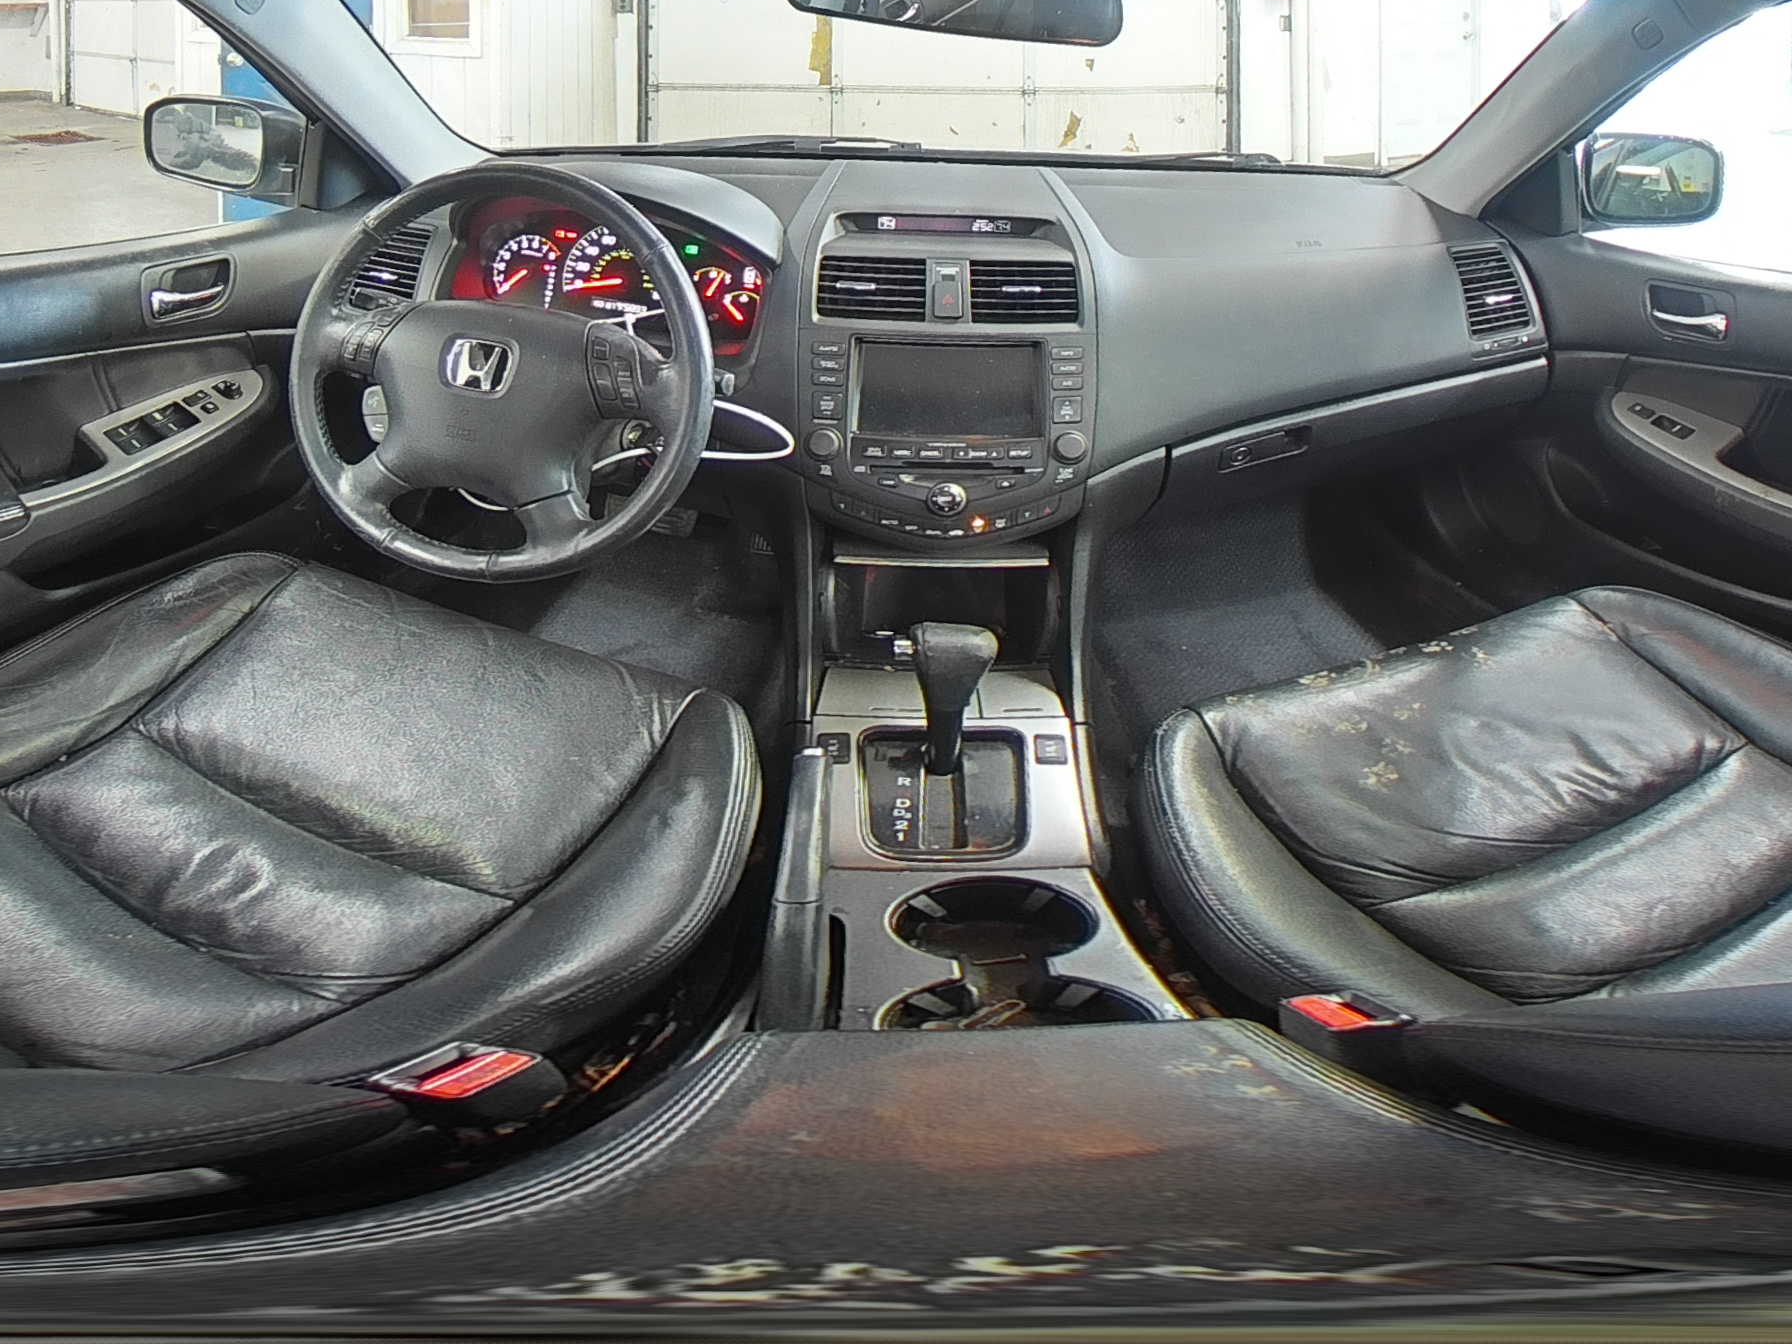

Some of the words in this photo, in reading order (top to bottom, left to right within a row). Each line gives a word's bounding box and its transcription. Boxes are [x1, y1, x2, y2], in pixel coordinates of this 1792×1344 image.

[897, 776, 912, 786] R
[895, 798, 911, 808] D
[893, 820, 909, 830] 2
[896, 831, 905, 841] 1
